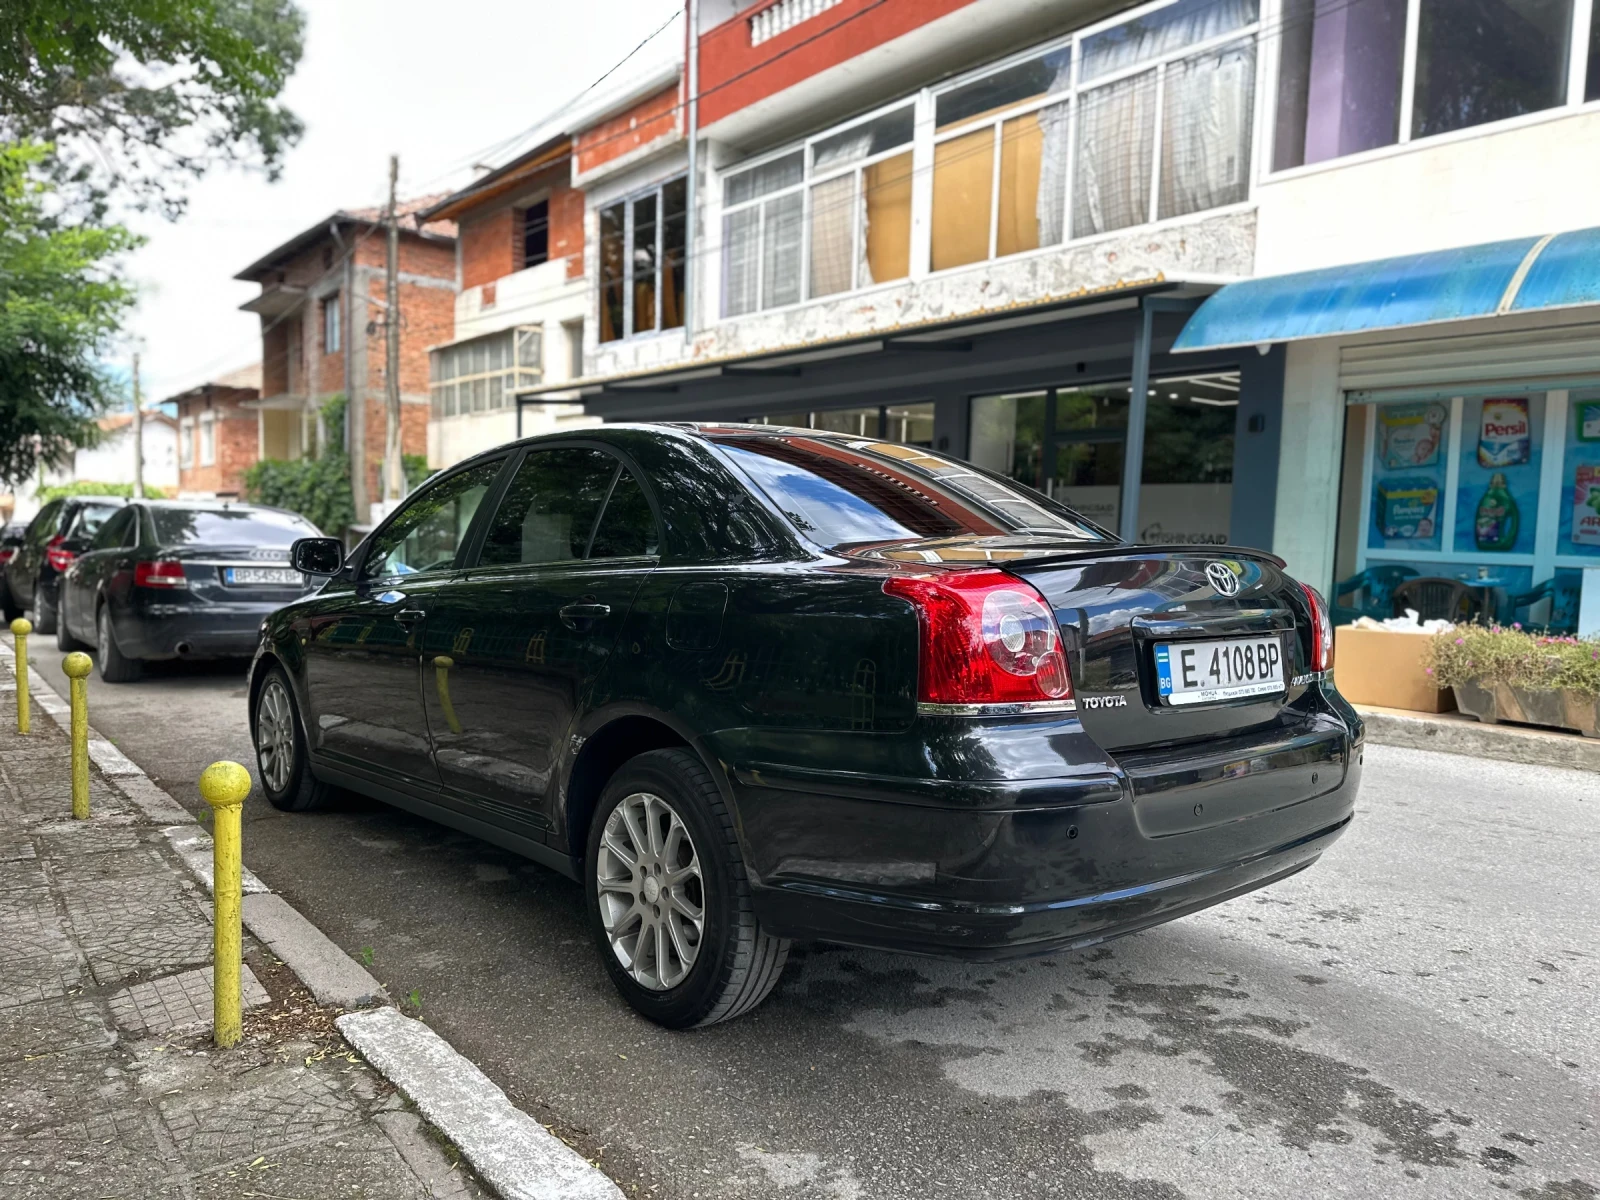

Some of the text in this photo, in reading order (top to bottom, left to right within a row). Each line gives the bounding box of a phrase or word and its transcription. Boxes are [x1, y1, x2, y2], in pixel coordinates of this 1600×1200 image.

[1485, 421, 1526, 437] Persil
[1160, 677, 1171, 689] BG
[1082, 695, 1127, 709] TOYOTA
